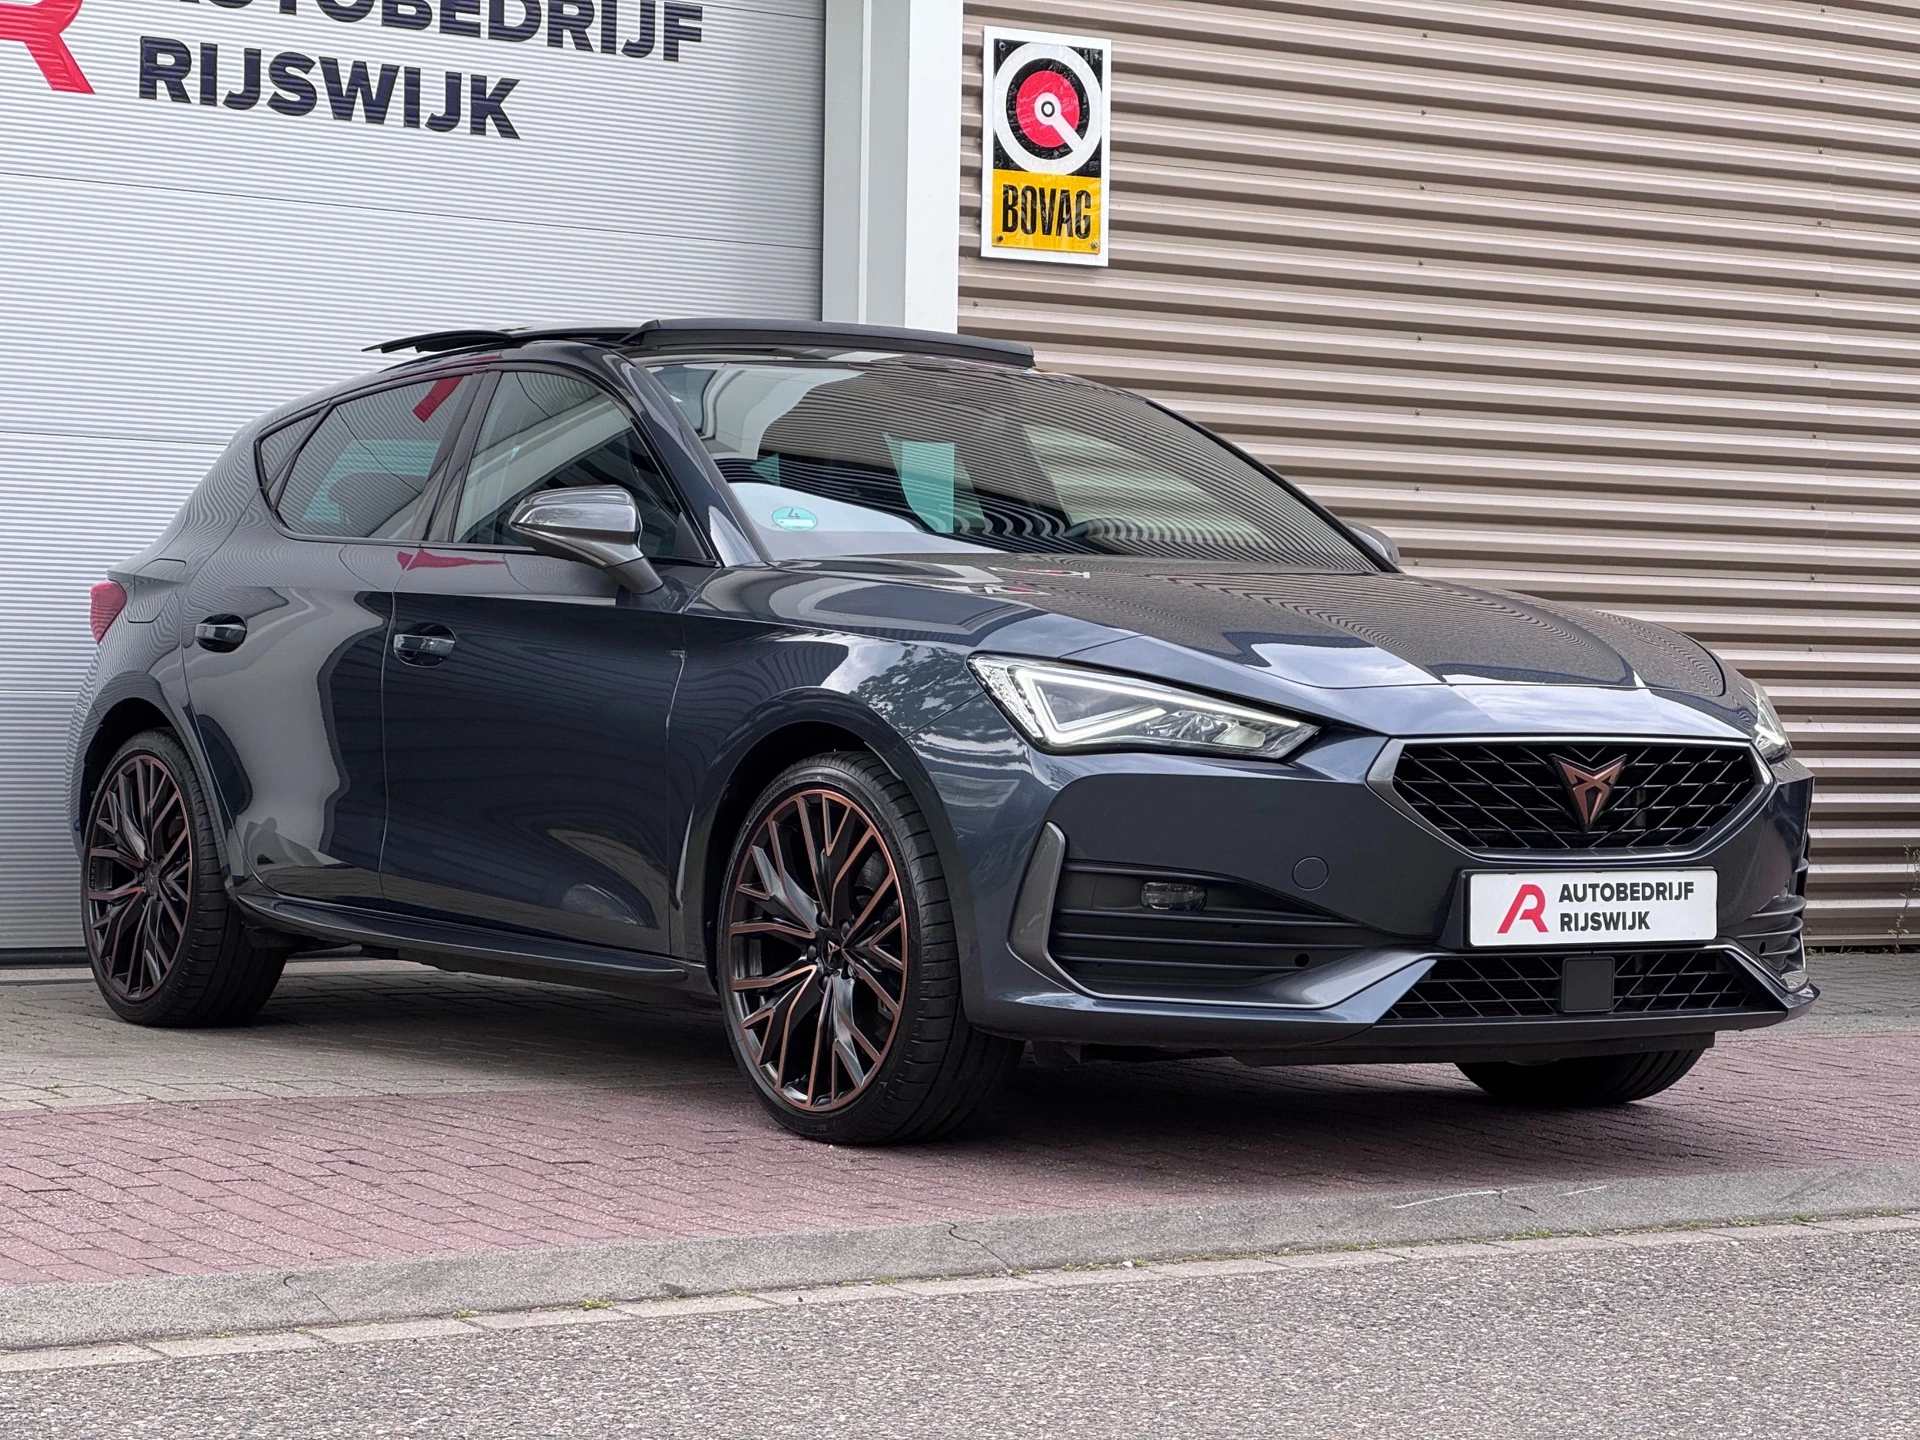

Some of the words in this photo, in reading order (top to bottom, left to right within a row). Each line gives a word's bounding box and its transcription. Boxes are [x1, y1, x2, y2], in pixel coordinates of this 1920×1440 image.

[179, 0, 703, 62] BEDRIJF
[139, 36, 521, 139] RIJSWIJK
[1002, 184, 1092, 239] BOVAG
[1558, 881, 1694, 903] AUTOBEDRIJF
[1559, 911, 1651, 932] RIJSWIJK
